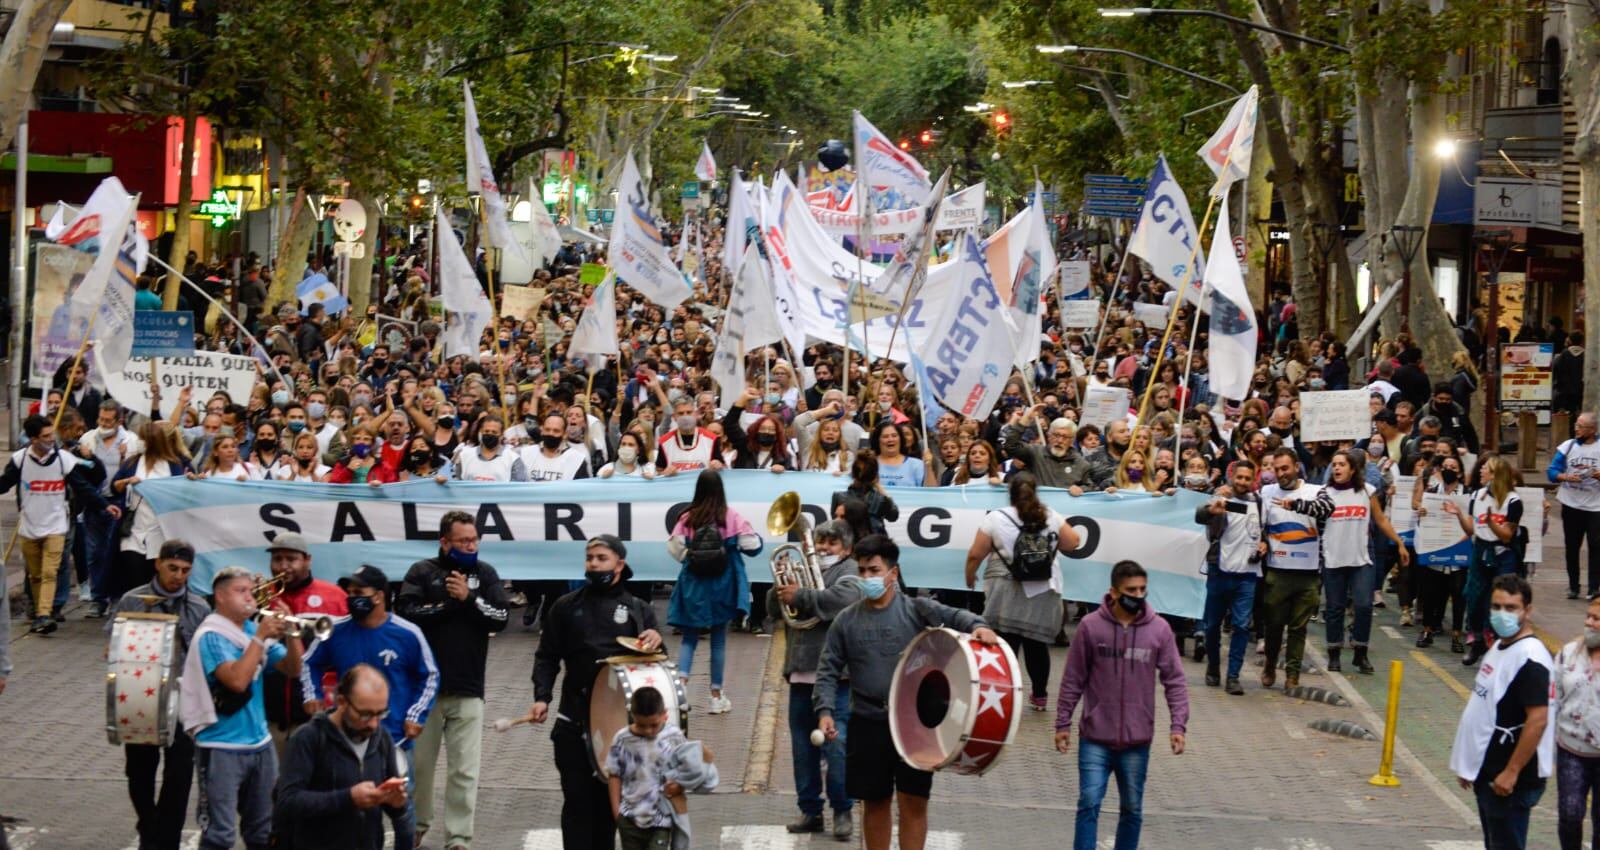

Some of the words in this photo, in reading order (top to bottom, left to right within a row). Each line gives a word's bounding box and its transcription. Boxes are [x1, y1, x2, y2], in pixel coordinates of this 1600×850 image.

[944, 208, 977, 218] FRENTE
[135, 317, 174, 327] SCUELA
[162, 356, 214, 368] FALTA
[221, 357, 256, 371] QUE
[123, 371, 153, 384] NOS
[530, 470, 564, 481] SUTE
